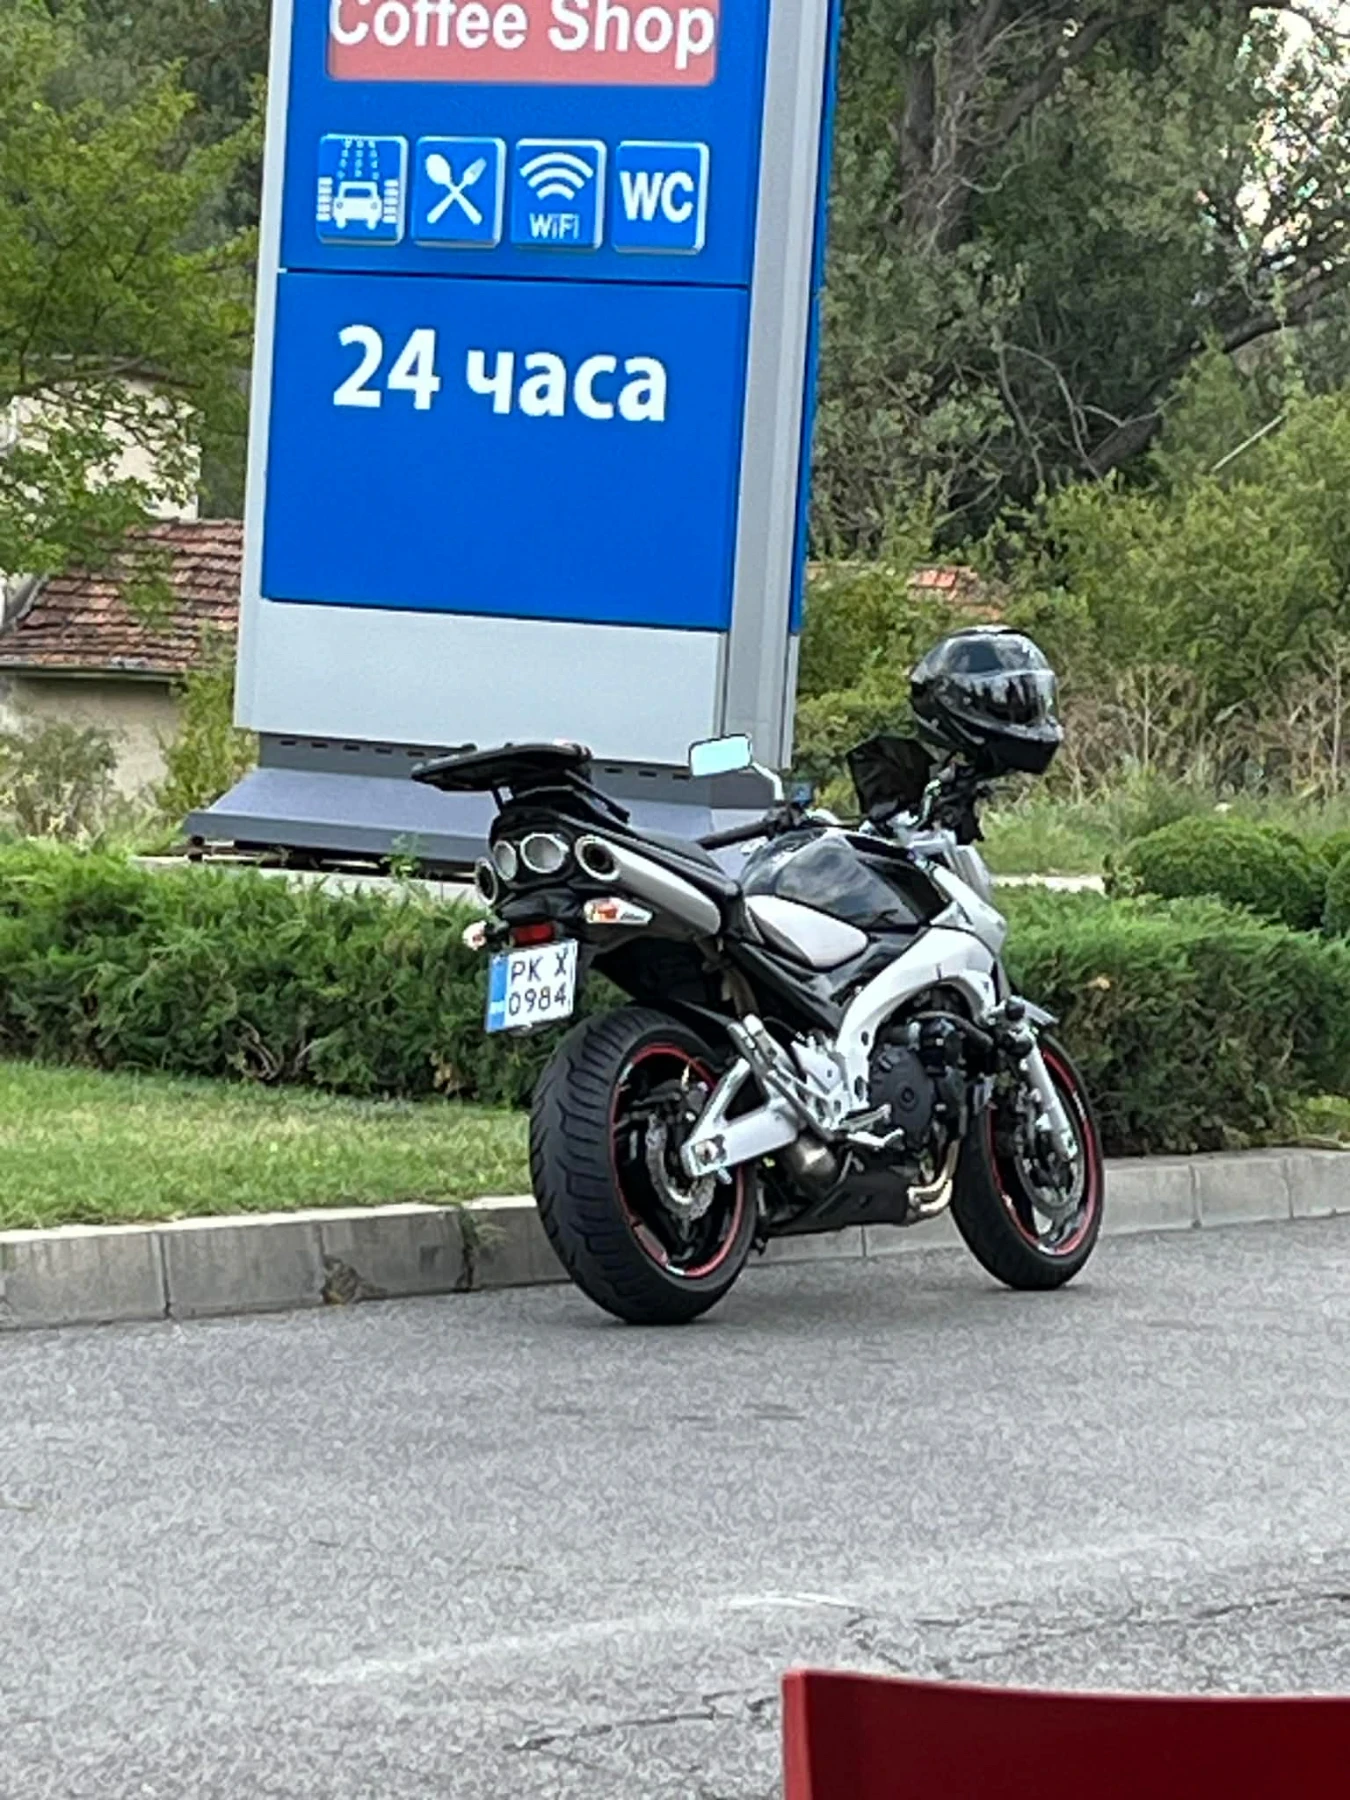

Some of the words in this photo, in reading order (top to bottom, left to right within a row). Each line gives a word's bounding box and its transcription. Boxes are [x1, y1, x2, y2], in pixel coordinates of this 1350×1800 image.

[329, 0, 528, 50] Coffee
[548, 0, 716, 70] Shop
[619, 171, 695, 223] WC
[333, 324, 440, 411] 24
[465, 348, 668, 423] часа
[509, 981, 567, 1016] 0984
